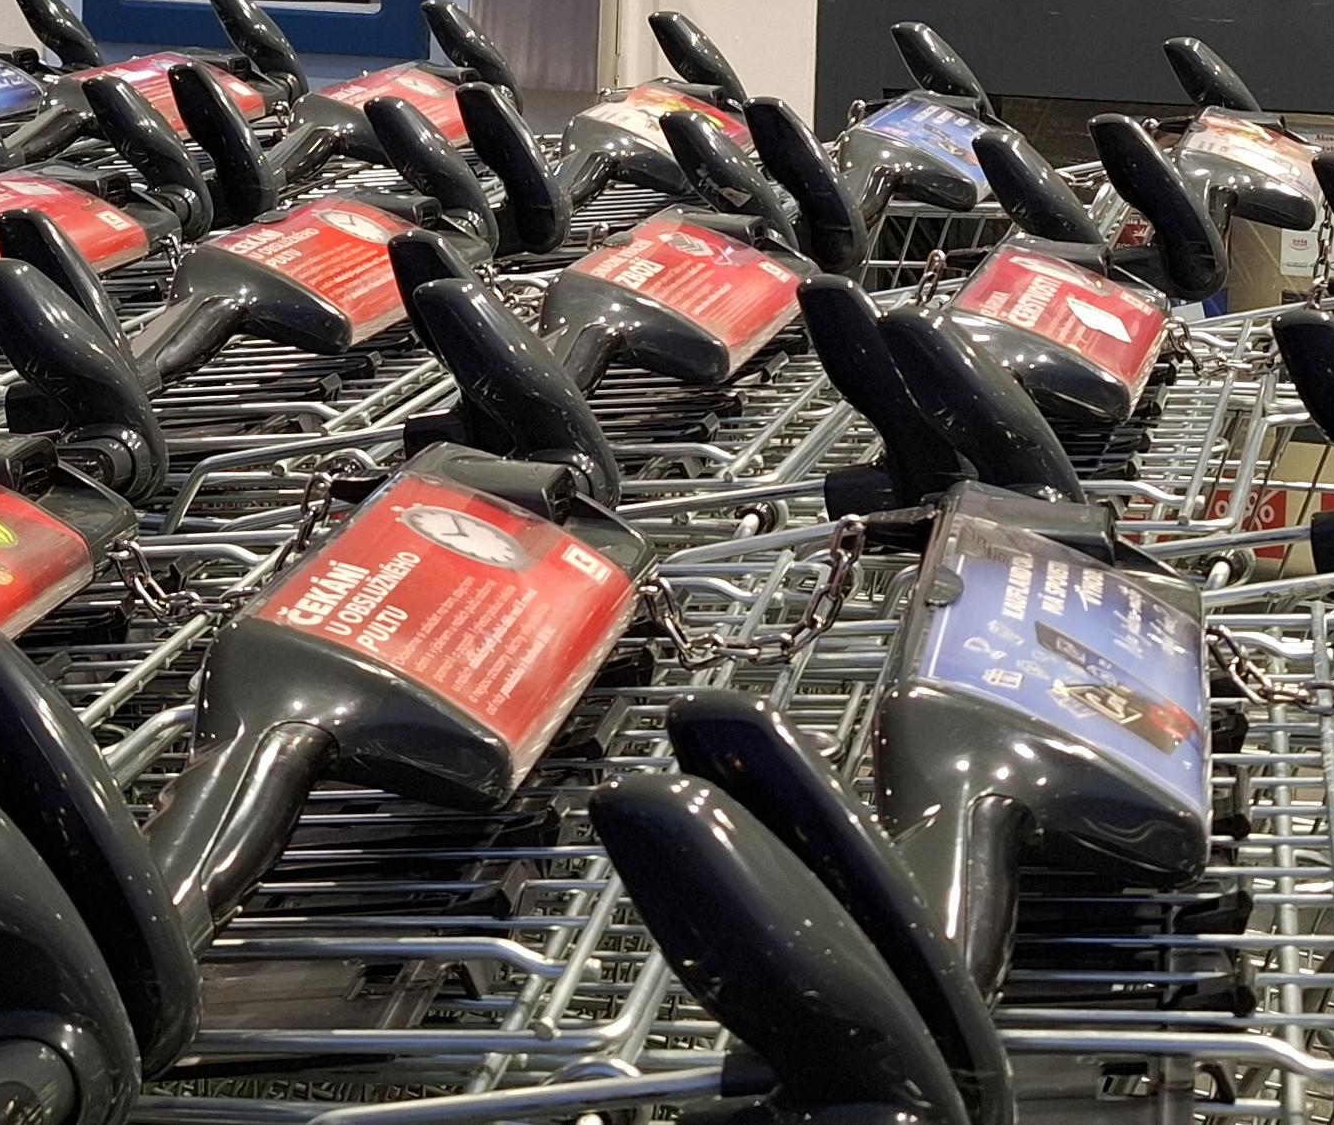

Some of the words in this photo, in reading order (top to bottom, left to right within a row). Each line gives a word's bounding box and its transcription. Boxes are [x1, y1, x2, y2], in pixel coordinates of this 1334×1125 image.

[224, 228, 286, 256] ČEKÁNÍ
[266, 247, 303, 268] PULTU
[614, 257, 665, 290] ZBOŽÍ
[1000, 275, 1063, 328] ČERSTVOSTI
[277, 560, 370, 625] ČEKÁNÍ
[337, 551, 421, 623] OBSLUŽNÉHO
[324, 621, 353, 636] U
[356, 605, 409, 652] PULTU
